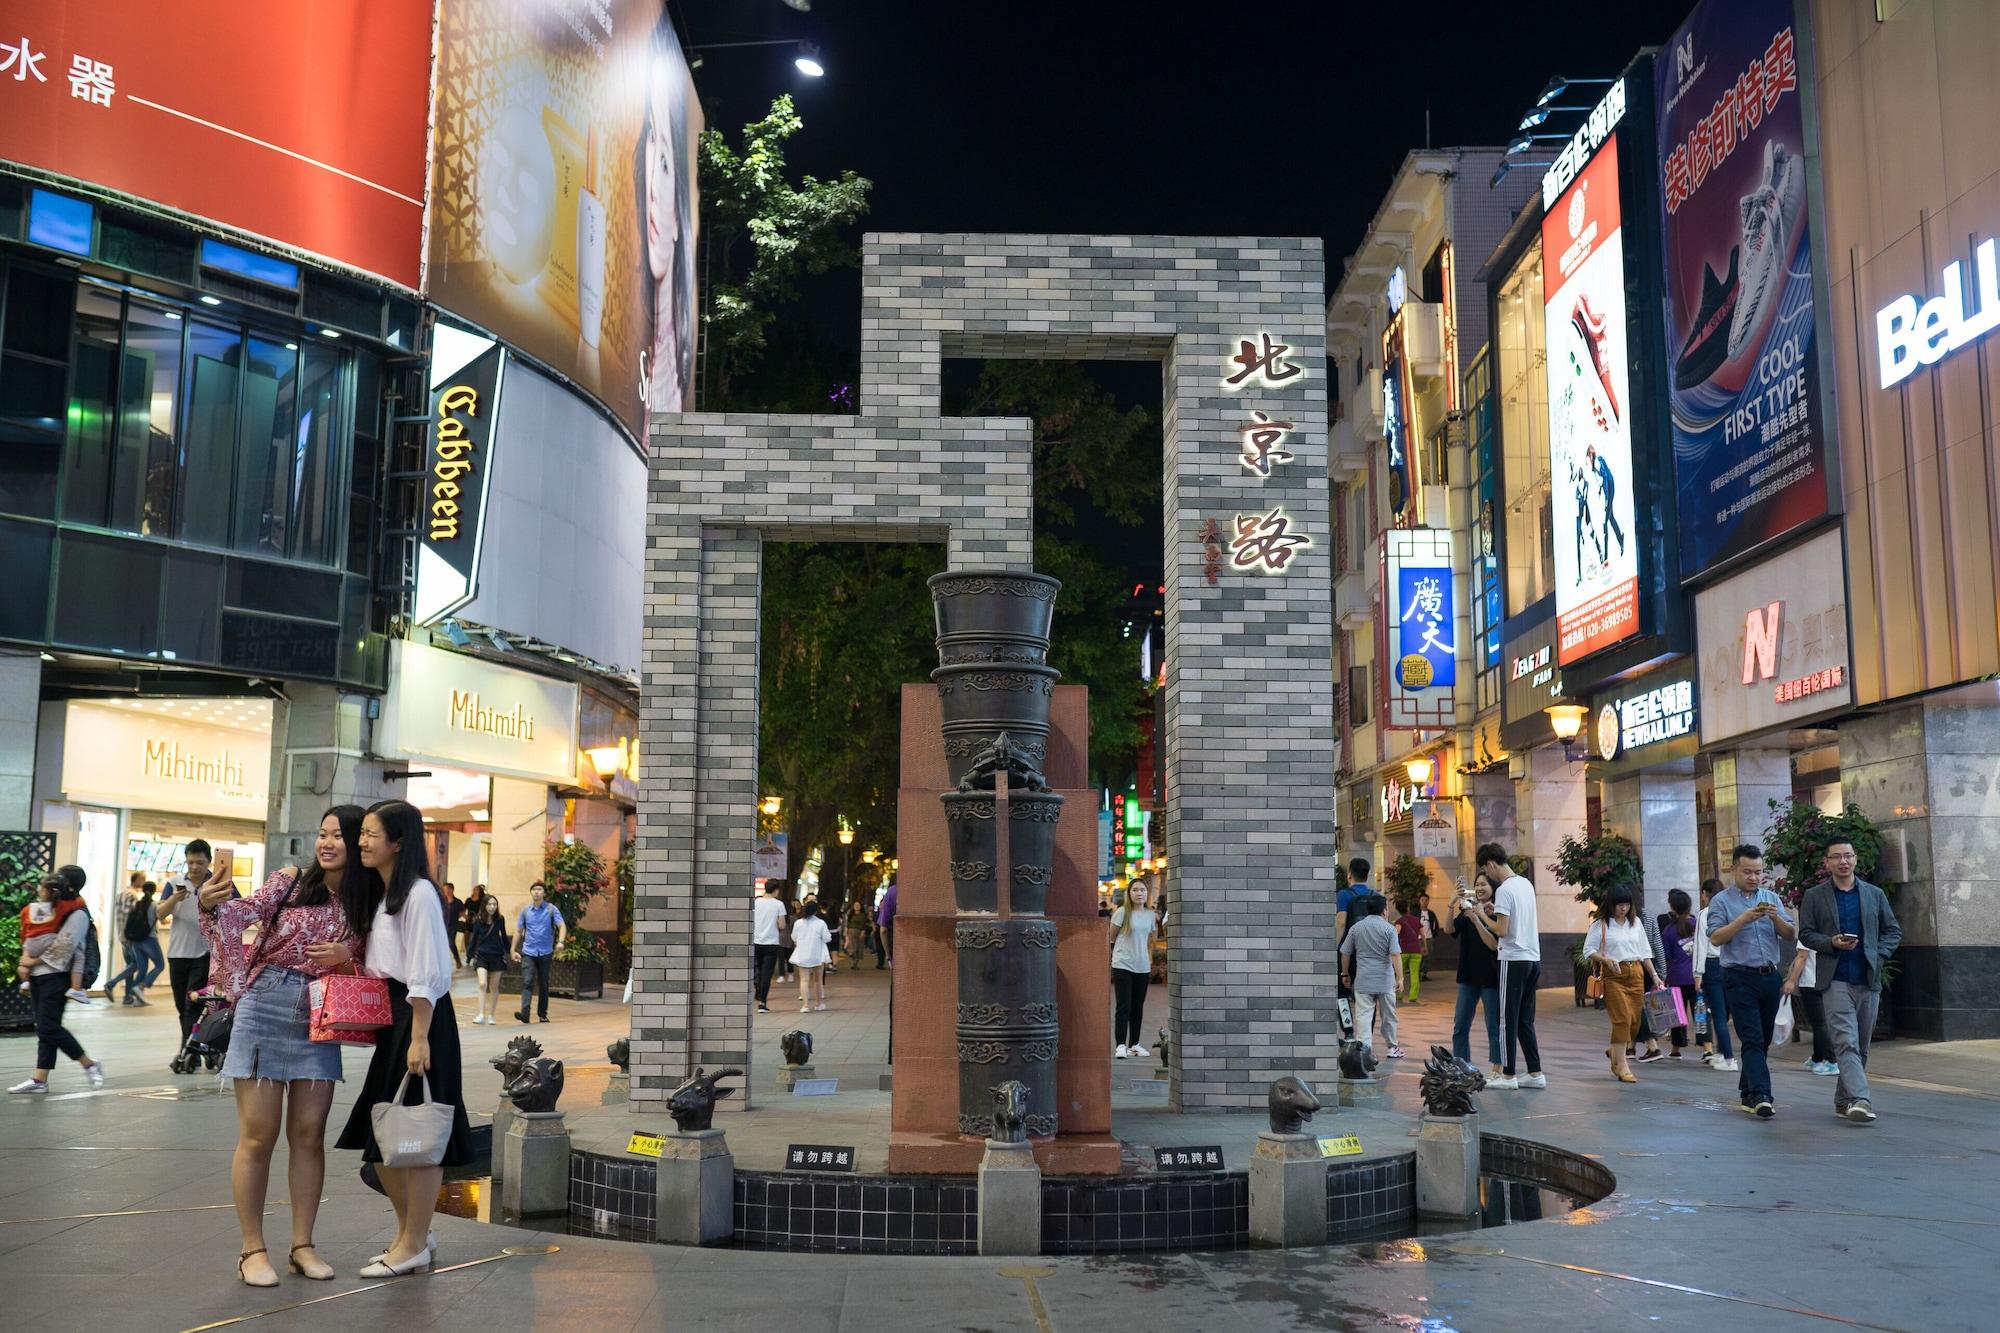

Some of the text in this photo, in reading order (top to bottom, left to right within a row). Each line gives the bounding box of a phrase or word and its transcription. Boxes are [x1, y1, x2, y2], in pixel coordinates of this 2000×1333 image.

[0, 37, 116, 108] 水器
[1664, 26, 1796, 215] 装修前特卖
[1759, 335, 1804, 385] COOL
[1724, 367, 1806, 445] FIRST TYPE
[1760, 398, 1809, 445] 潮酷先型者
[430, 385, 477, 540] Cabbeen
[1226, 332, 1310, 569] 北京路
[1742, 601, 1782, 685] N
[1621, 680, 1693, 729] 新百伦领跑
[1775, 667, 1843, 704] 美国纽百伦国际
[450, 690, 534, 741] Mihimihi
[144, 739, 243, 786] Mihimihi
[792, 1150, 848, 1165] 请勿跨越
[1161, 1152, 1218, 1165] 请勿跨越
